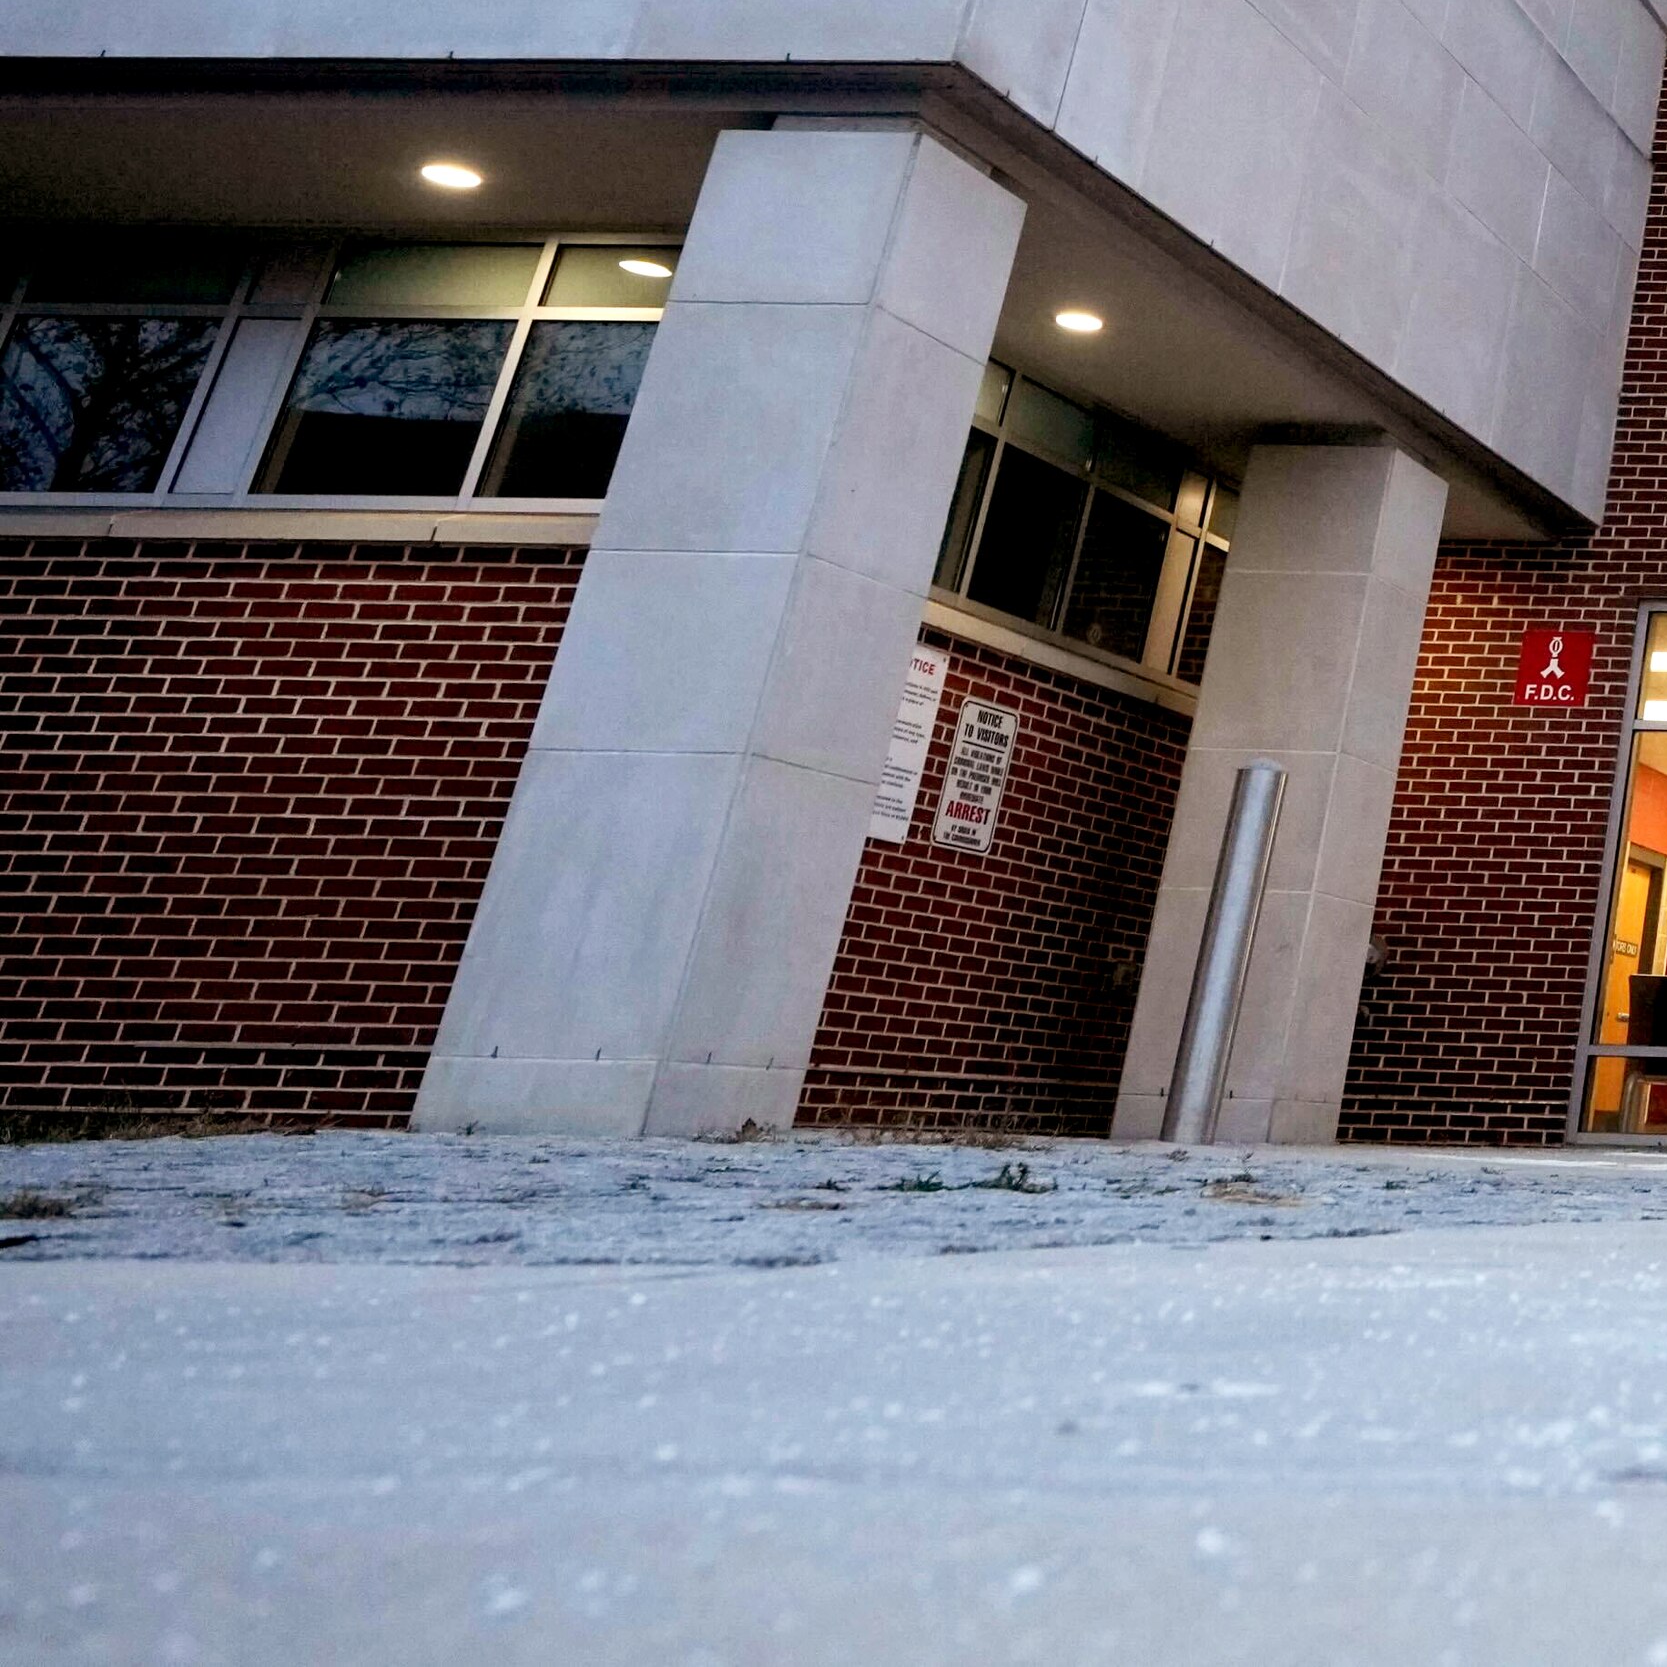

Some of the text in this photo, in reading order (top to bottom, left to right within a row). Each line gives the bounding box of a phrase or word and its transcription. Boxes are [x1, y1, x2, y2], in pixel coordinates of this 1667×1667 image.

[1524, 684, 1574, 701] F.D.C.
[977, 710, 1004, 729] NOTICE
[964, 723, 1010, 748] TO VISITORS
[945, 800, 991, 825] ARREST
